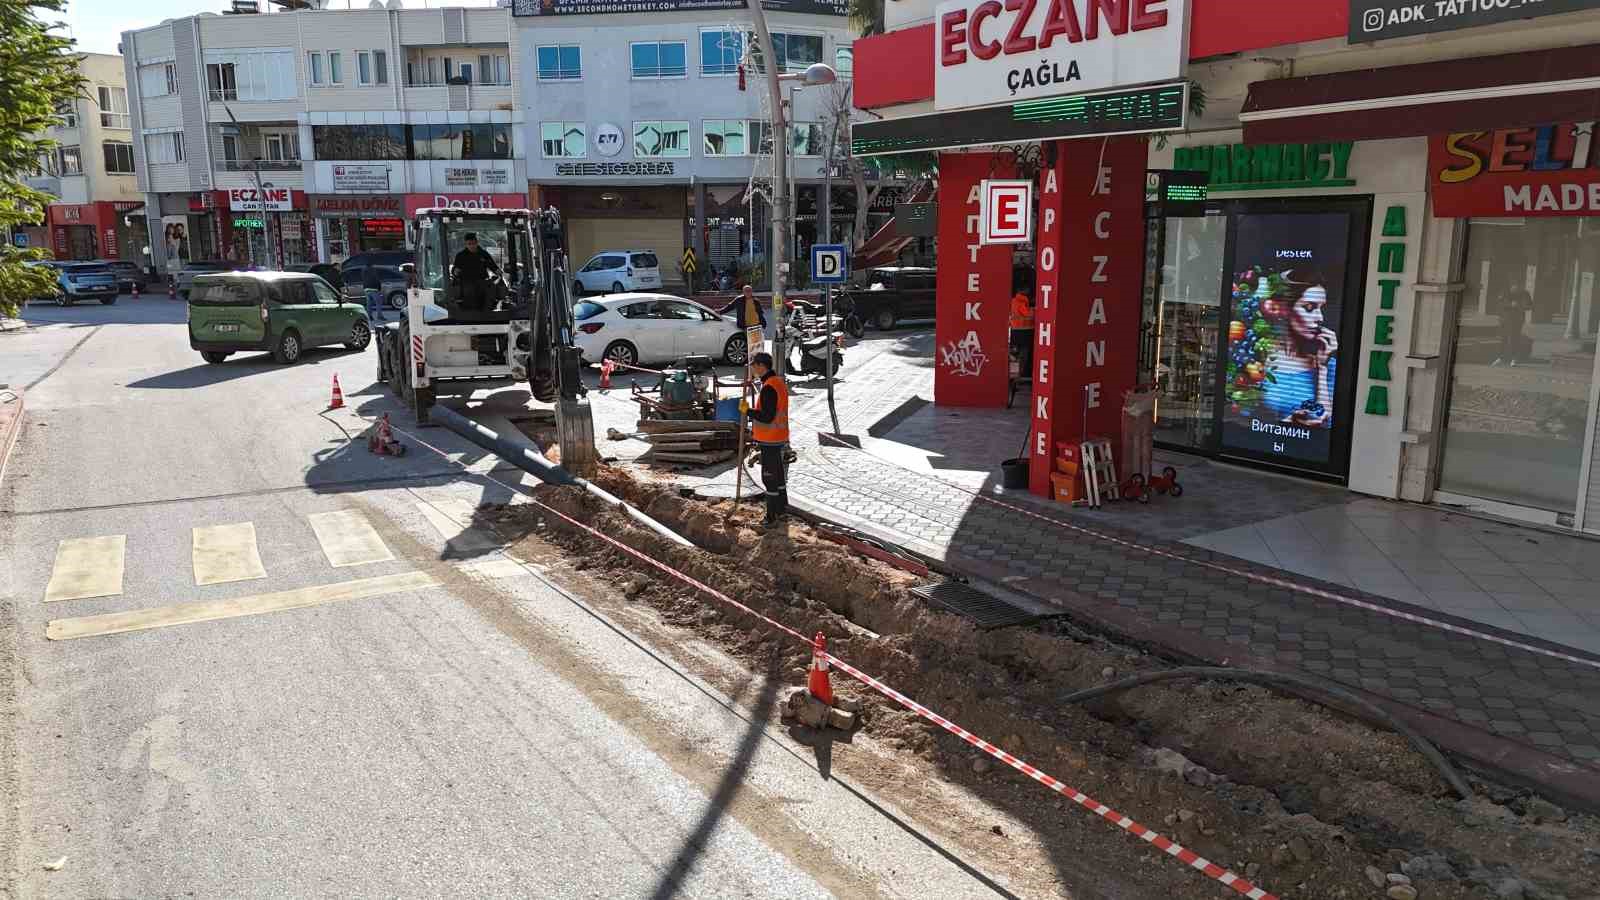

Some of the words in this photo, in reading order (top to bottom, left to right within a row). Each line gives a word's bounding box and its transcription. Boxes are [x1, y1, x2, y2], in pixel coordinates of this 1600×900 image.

[941, 0, 1169, 67] ECZANE
[1007, 59, 1082, 95] ÇAĞLA
[1174, 141, 1355, 183] PHARMACY
[998, 195, 1020, 230] E
[821, 254, 837, 275] D
[1086, 167, 1113, 409] ECZANE
[1036, 168, 1058, 456] APOTHEKE
[1365, 206, 1407, 416] АПТЕКА
[1251, 418, 1311, 440] Витамин
